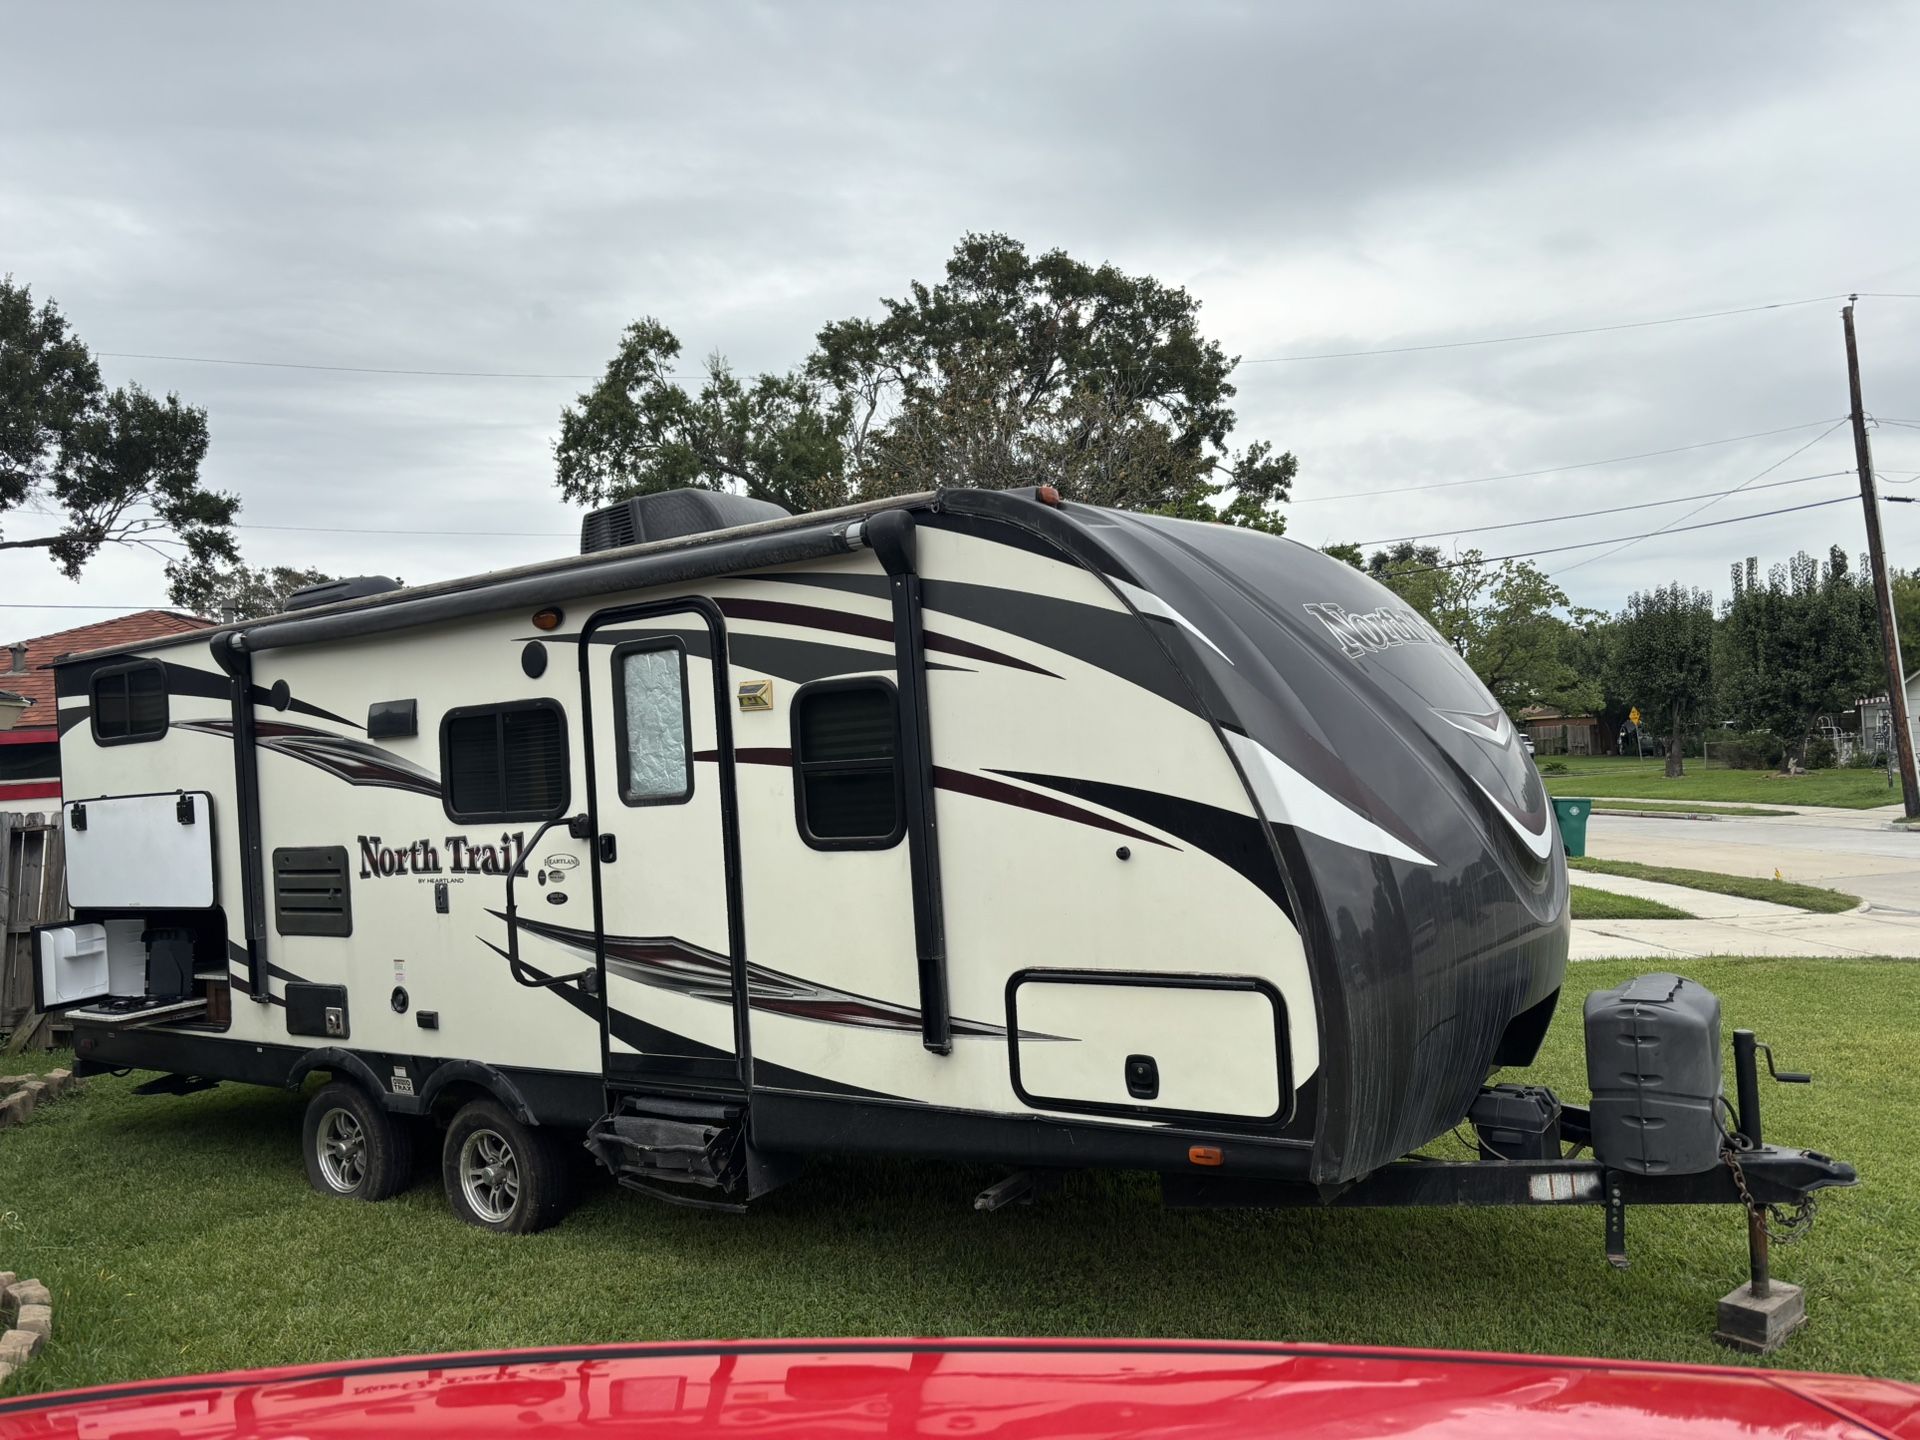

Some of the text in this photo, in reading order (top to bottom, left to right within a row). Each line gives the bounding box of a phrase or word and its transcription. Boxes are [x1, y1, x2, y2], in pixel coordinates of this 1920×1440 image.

[1303, 603, 1431, 659] North
[357, 831, 529, 879] North Trail
